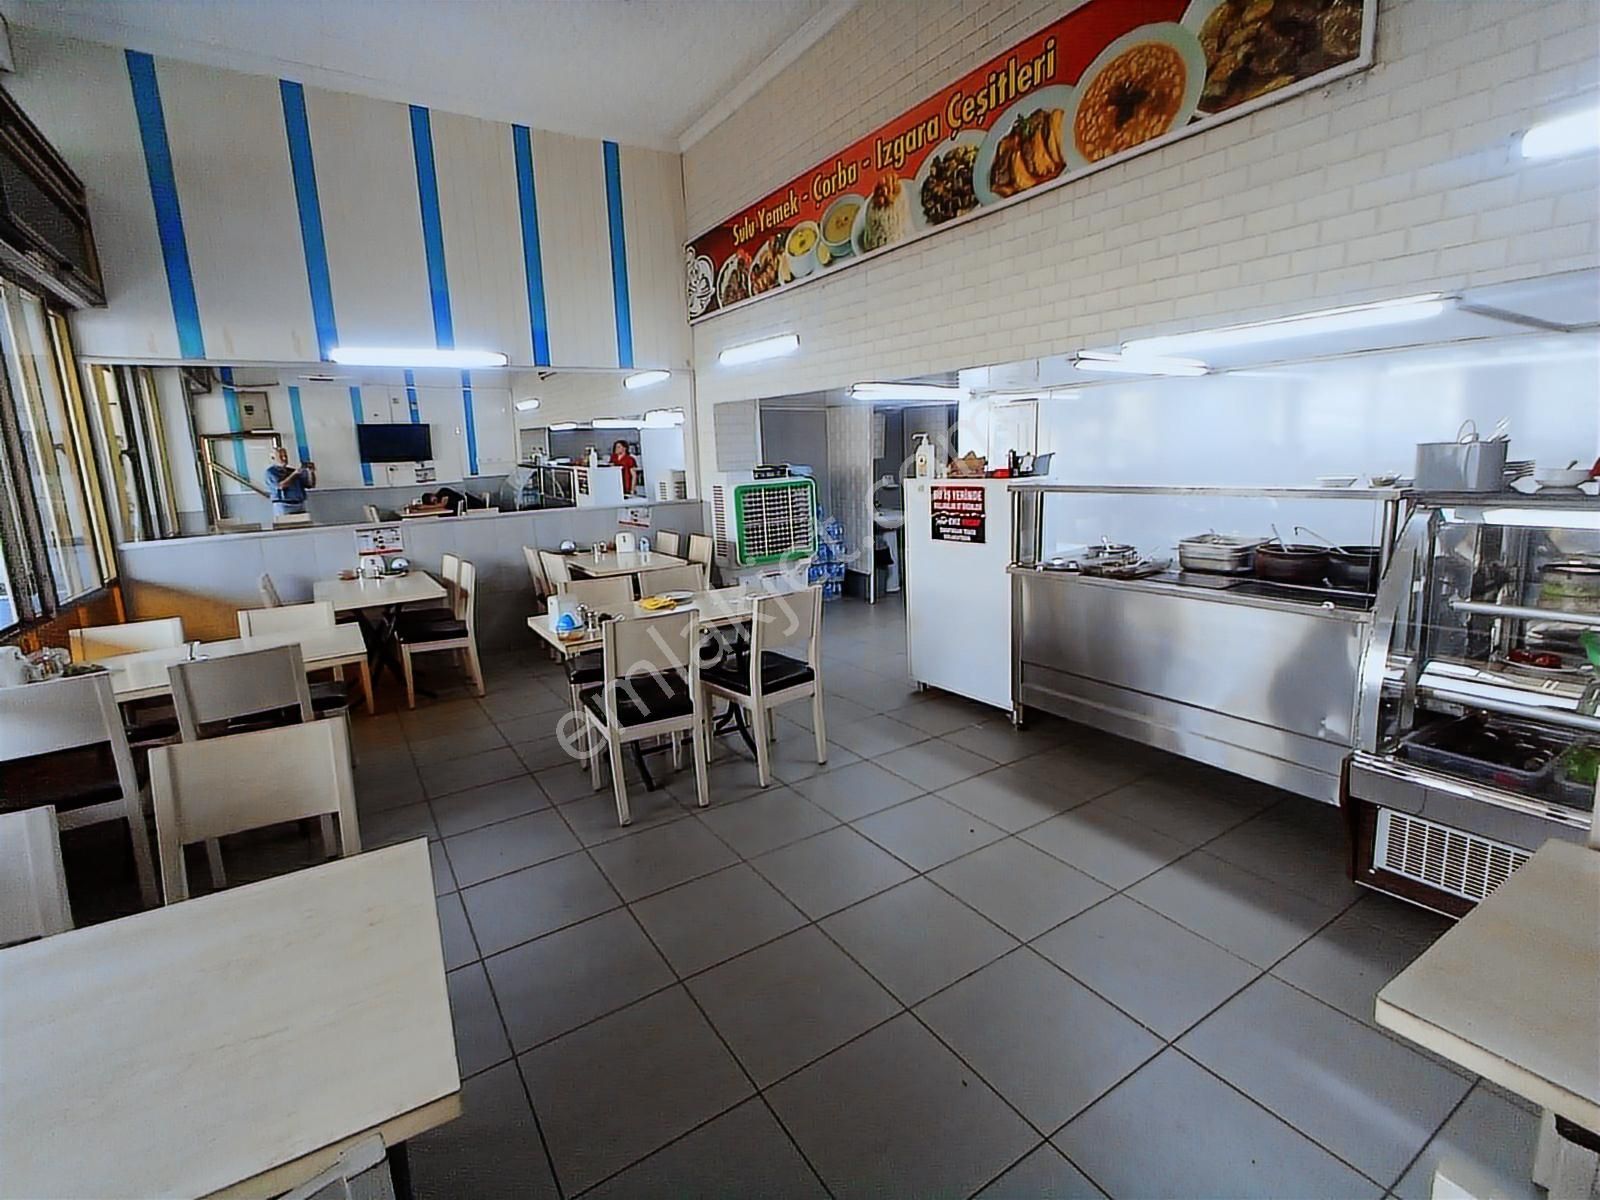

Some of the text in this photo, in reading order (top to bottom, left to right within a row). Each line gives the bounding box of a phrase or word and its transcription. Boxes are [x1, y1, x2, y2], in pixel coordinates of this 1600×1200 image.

[733, 217, 755, 246] Sulu
[757, 189, 798, 232] Yemek
[813, 157, 857, 209] Çorba
[876, 113, 939, 169] Izgara
[948, 38, 1056, 140] Çeşitleri
